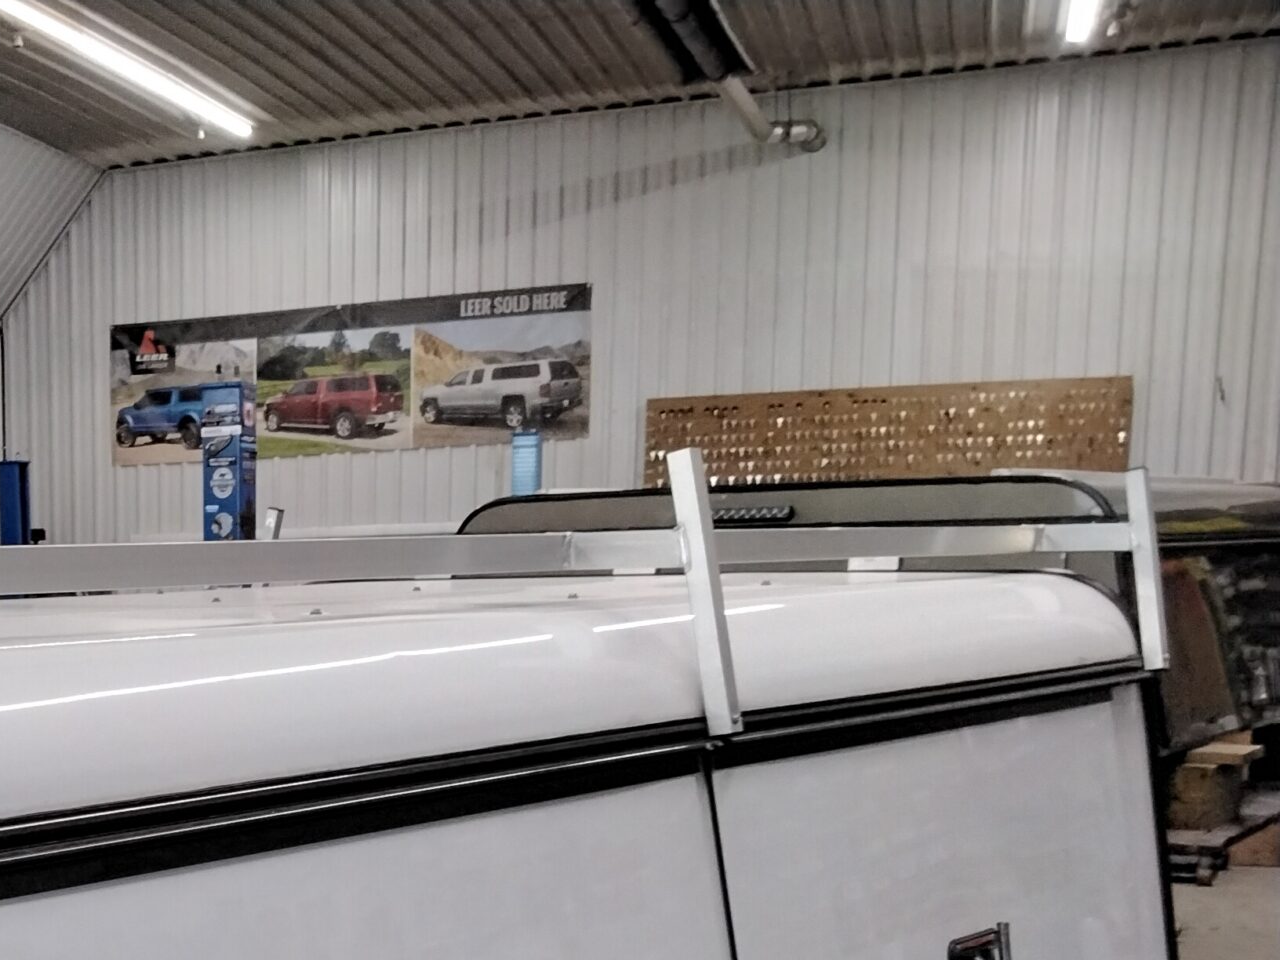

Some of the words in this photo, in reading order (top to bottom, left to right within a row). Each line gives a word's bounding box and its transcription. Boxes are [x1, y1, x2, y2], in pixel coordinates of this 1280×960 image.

[460, 298, 491, 317] LEER
[494, 294, 529, 314] SOLD
[532, 291, 567, 311] HERE
